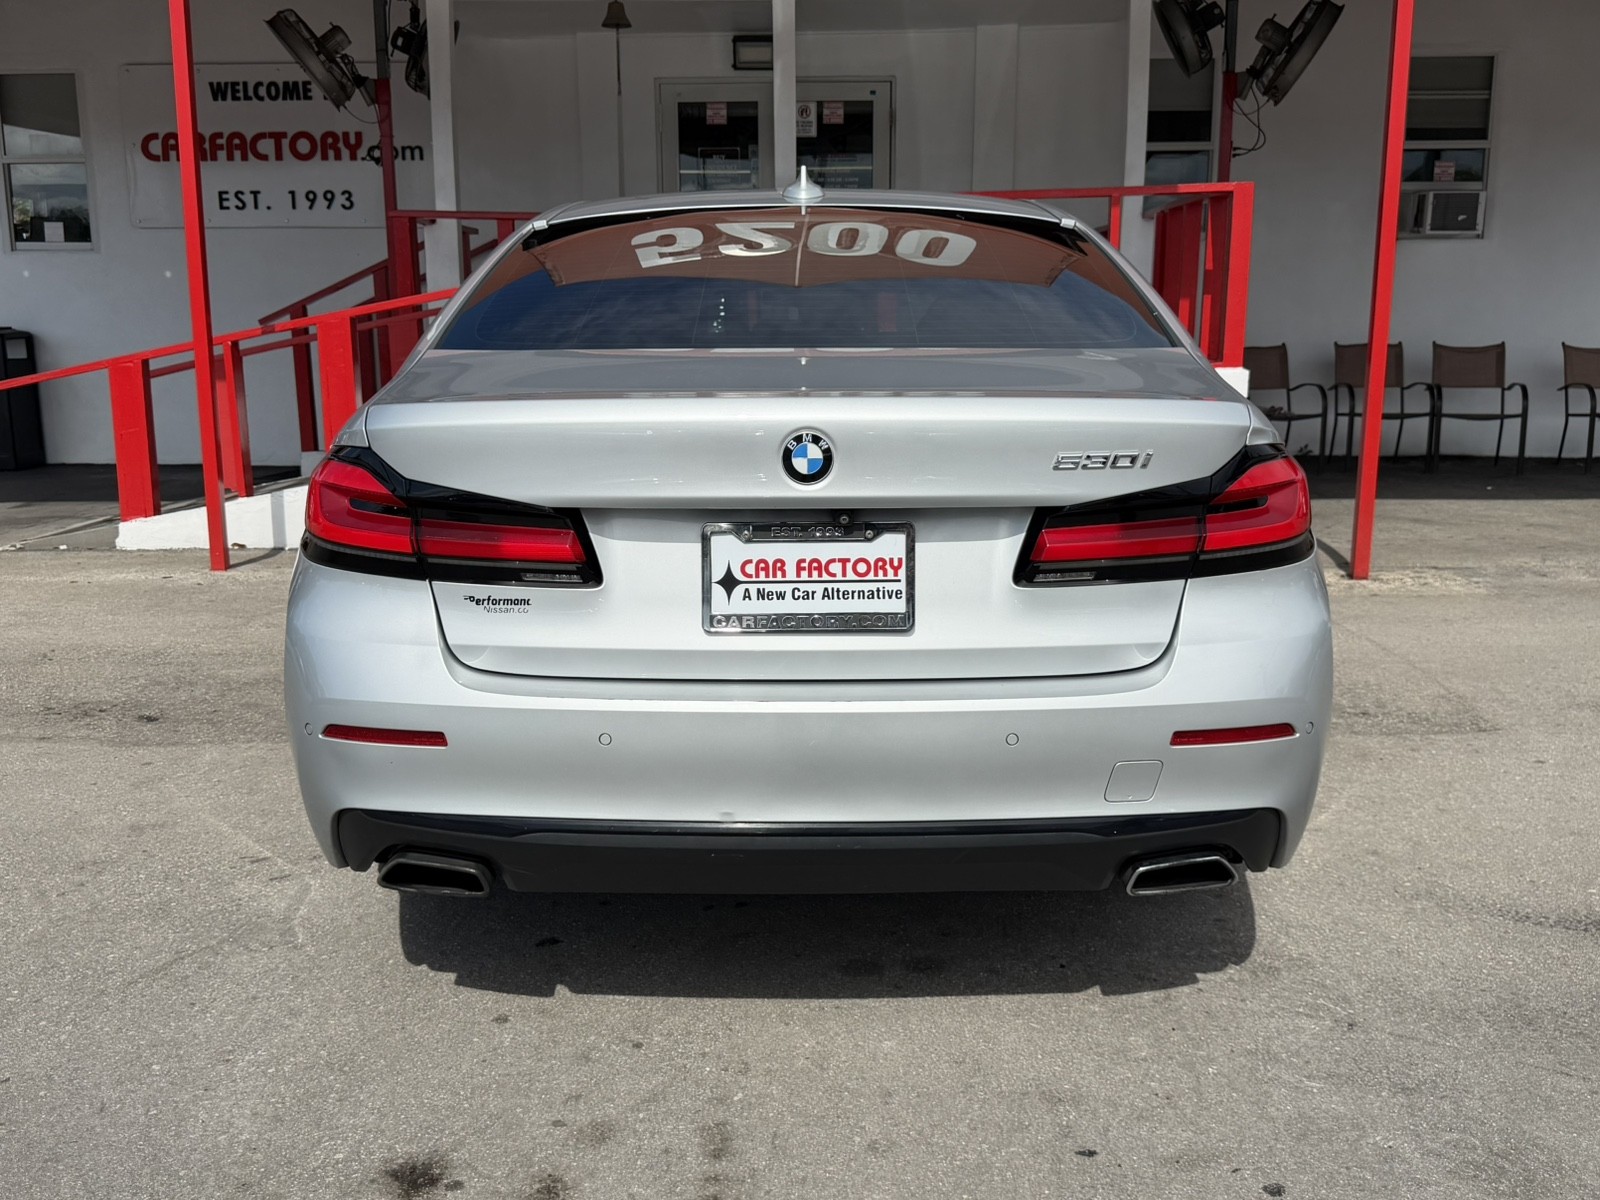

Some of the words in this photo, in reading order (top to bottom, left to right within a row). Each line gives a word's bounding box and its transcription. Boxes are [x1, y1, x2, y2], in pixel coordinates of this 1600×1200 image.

[208, 80, 313, 102] WELCOME
[217, 190, 272, 210] EST.
[288, 189, 355, 211] 1993
[787, 432, 829, 450] BMW
[1052, 449, 1154, 471] 530i
[771, 526, 803, 537] EST.
[739, 557, 787, 579] CAR
[795, 556, 903, 578] FACTORY
[742, 588, 752, 601] A
[756, 588, 787, 601] New
[791, 587, 817, 601] Car
[821, 586, 903, 600] Alternative
[712, 613, 905, 629] CARFACTORY.COM
